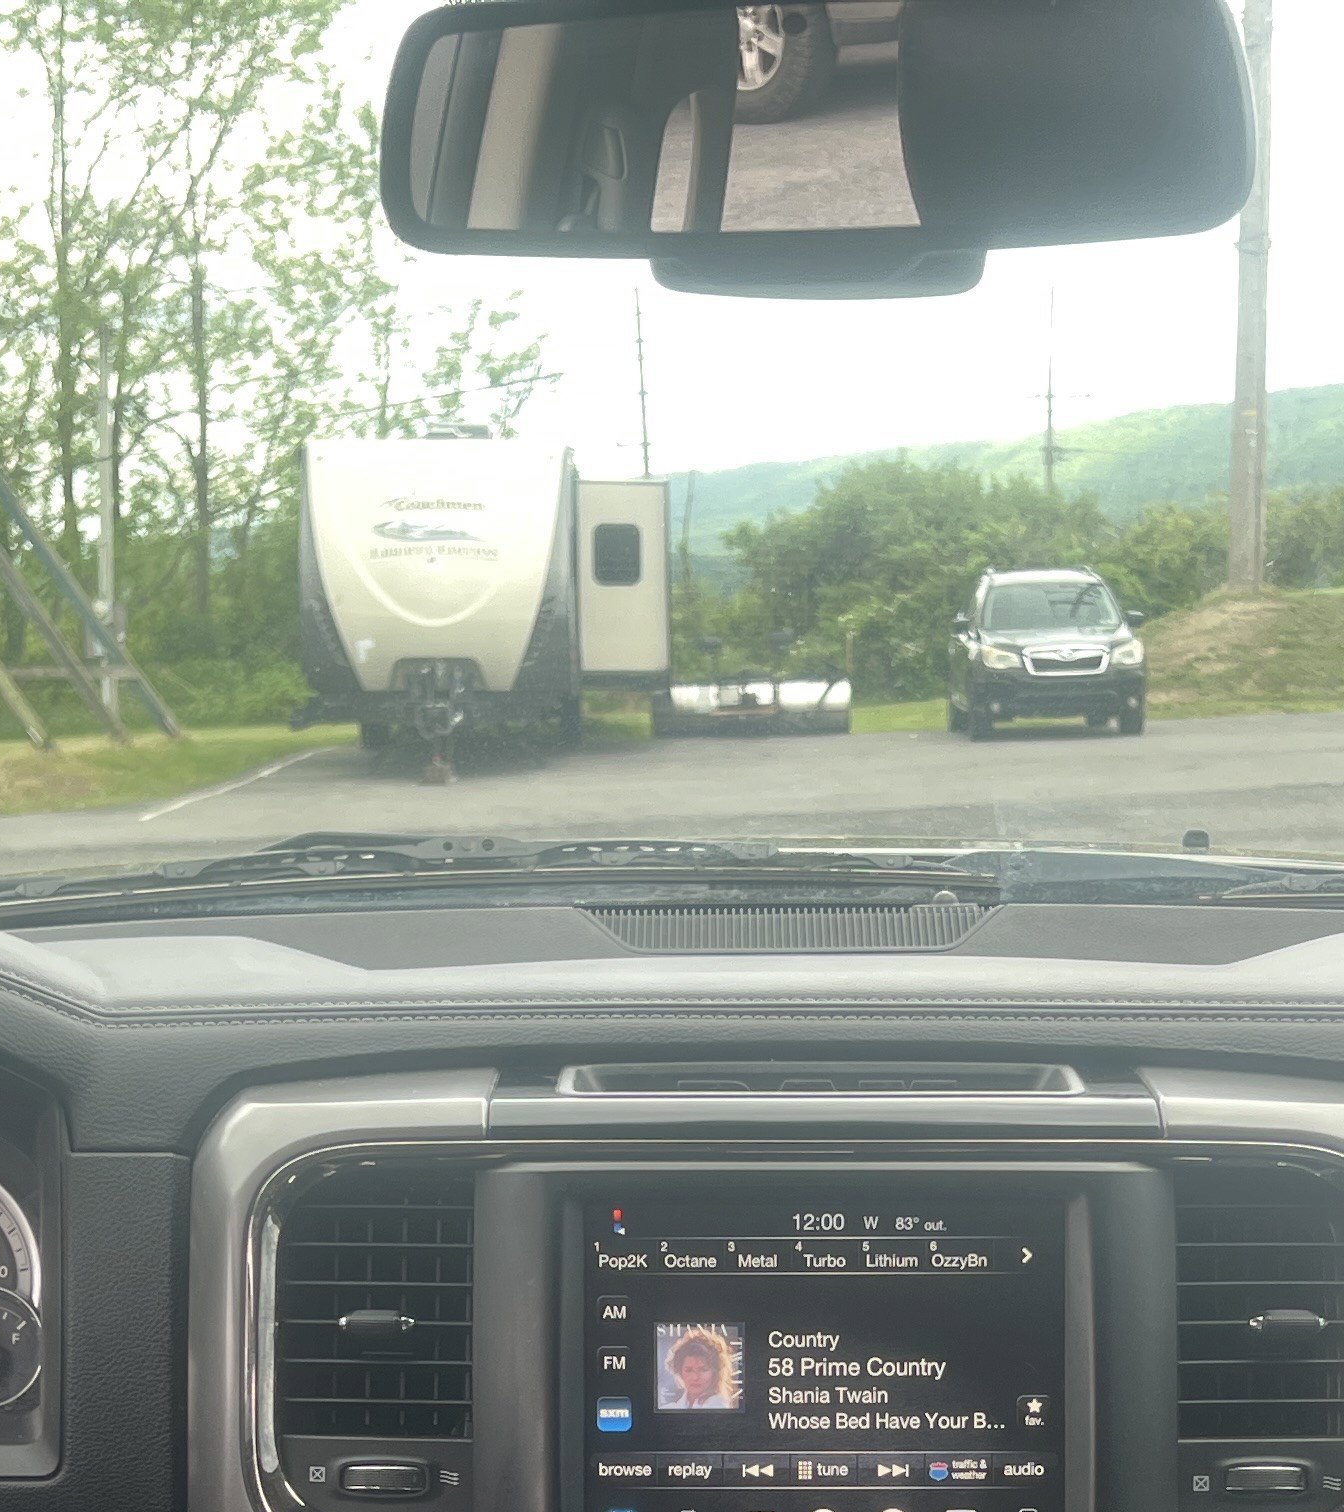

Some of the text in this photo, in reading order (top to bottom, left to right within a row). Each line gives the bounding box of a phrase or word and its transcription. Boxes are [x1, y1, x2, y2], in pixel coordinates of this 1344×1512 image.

[792, 1213, 845, 1232] 12:00
[863, 1215, 879, 1231] W
[894, 1216, 948, 1232] 83° out.
[593, 1241, 601, 1252] 1
[660, 1241, 668, 1252] 2
[727, 1241, 735, 1252] 3
[794, 1241, 803, 1251] 4
[861, 1241, 870, 1252] 5
[929, 1241, 938, 1252] 6
[598, 1254, 648, 1271] Pop2K
[664, 1254, 717, 1269] Octane
[737, 1254, 778, 1268] Metal
[803, 1253, 847, 1268] Turbo
[866, 1253, 918, 1268] Lithium
[931, 1253, 988, 1271] OzzyBn
[602, 1305, 627, 1320] AM
[11, 1332, 21, 1345] F
[768, 1331, 840, 1352] Country
[603, 1356, 626, 1370] FM
[768, 1356, 947, 1381] 58 Prime Country
[768, 1387, 889, 1404] Shania Twain
[599, 1408, 629, 1418] sxm
[768, 1413, 831, 1430] Whose
[836, 1413, 870, 1429] Bed
[876, 1413, 921, 1429] Have
[925, 1412, 969, 1429] Your
[1024, 1415, 1045, 1427] fav.
[598, 1462, 653, 1477] browse
[668, 1462, 713, 1480] replay
[817, 1462, 849, 1477] tune
[951, 1458, 988, 1470] traffic &
[1003, 1462, 1045, 1477] audio
[951, 1470, 988, 1480] weather
